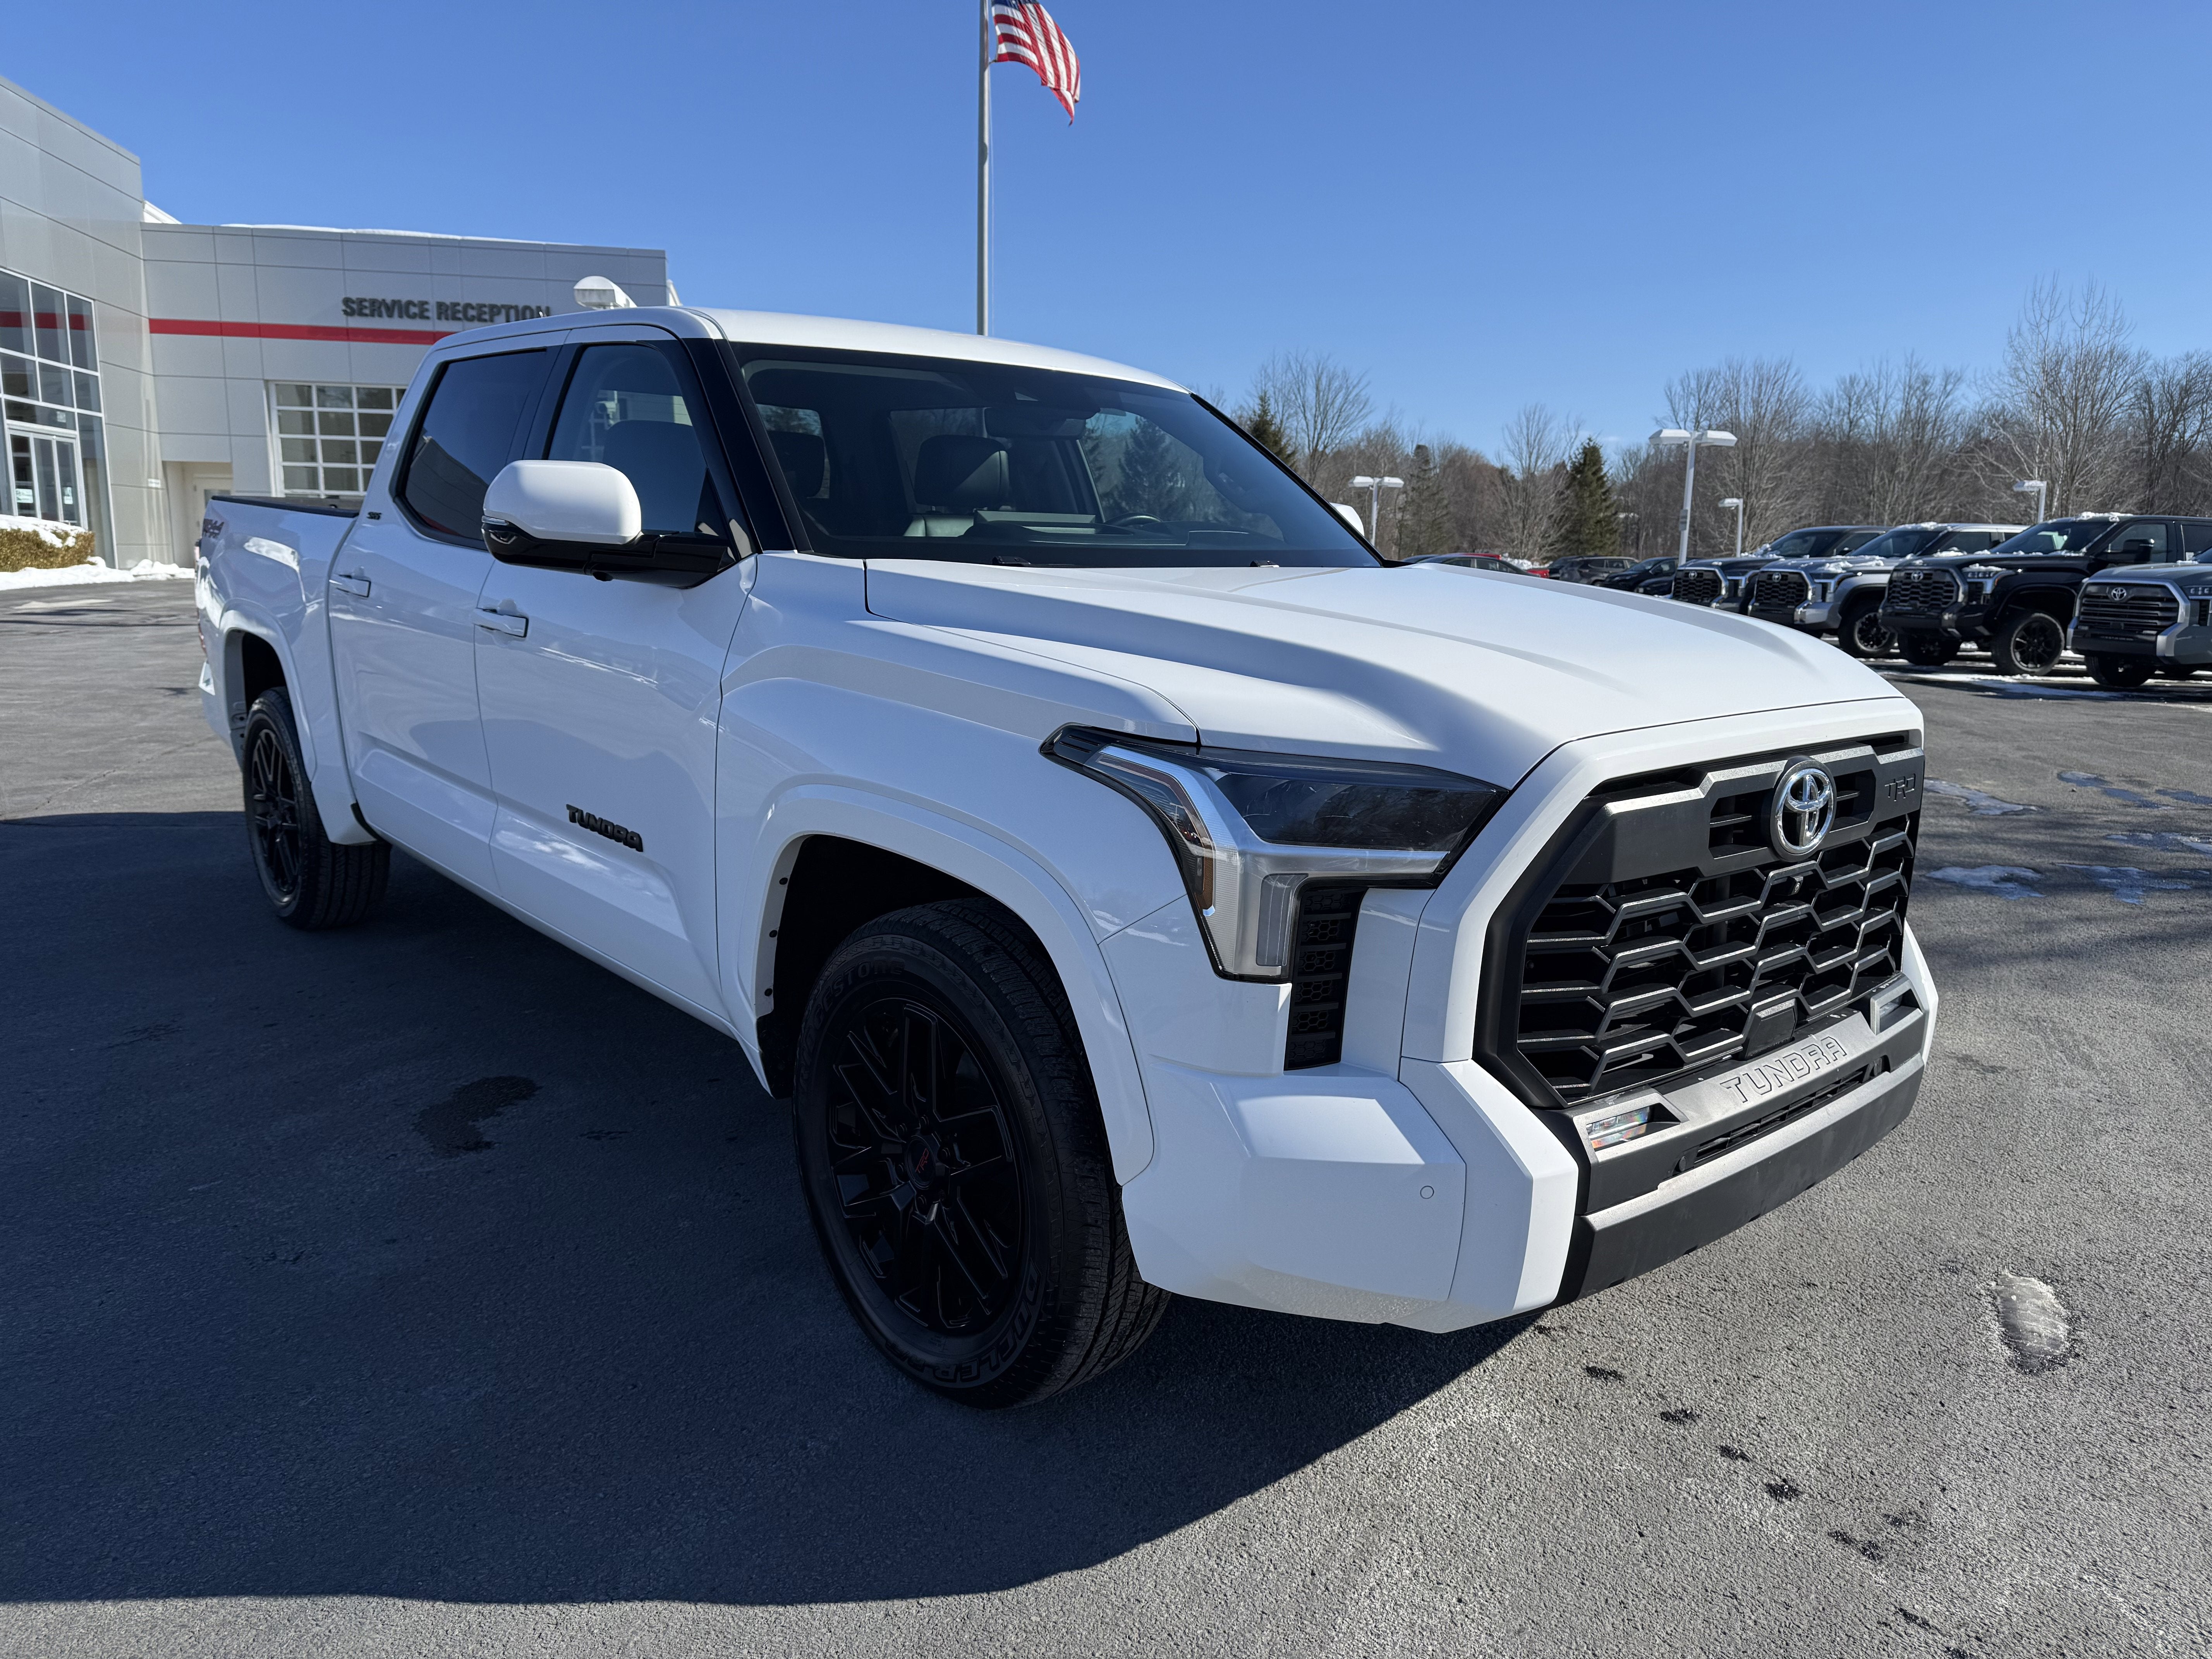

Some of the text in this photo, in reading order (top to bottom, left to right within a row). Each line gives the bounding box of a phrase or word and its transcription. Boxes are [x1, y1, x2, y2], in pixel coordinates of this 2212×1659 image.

[342, 297, 550, 323] SERVICE RECEPTION
[1884, 773, 1916, 802] TRD
[566, 804, 644, 852] TUNDRA
[1720, 1036, 1848, 1104] TUNDRA
[914, 1147, 929, 1174] TRD
